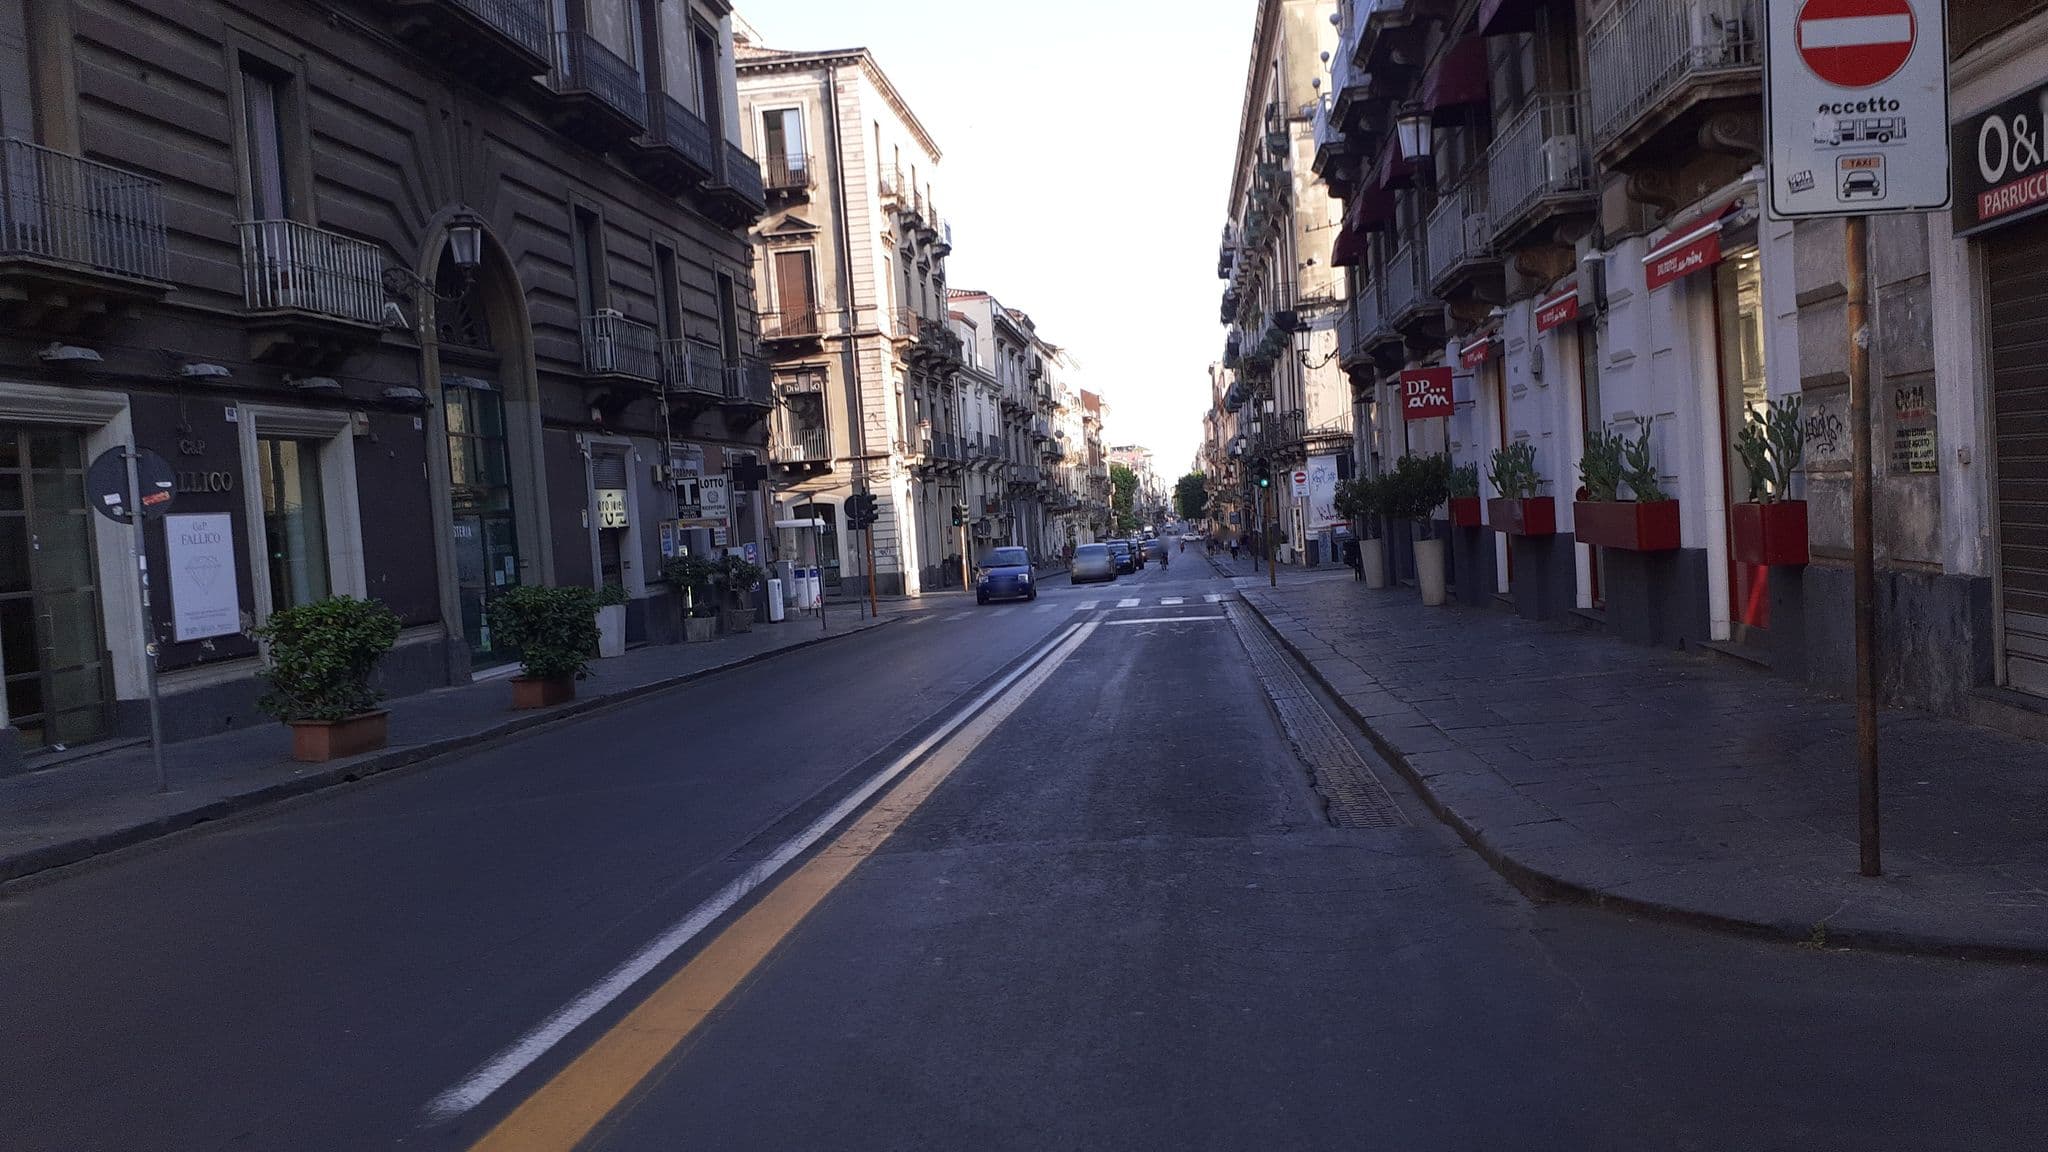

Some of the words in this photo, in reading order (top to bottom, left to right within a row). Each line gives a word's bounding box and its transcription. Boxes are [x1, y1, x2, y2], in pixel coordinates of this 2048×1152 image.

[1818, 96, 1900, 115] eccetto
[1977, 110, 2048, 184] O&
[1850, 159, 1872, 168] TAXI
[1984, 171, 2048, 216] PARRUCC
[1408, 393, 1450, 409] am
[175, 471, 234, 492] LLICO
[700, 478, 724, 488] LOTTO
[181, 532, 222, 545] FALLICO
[452, 524, 472, 538] STERIA
